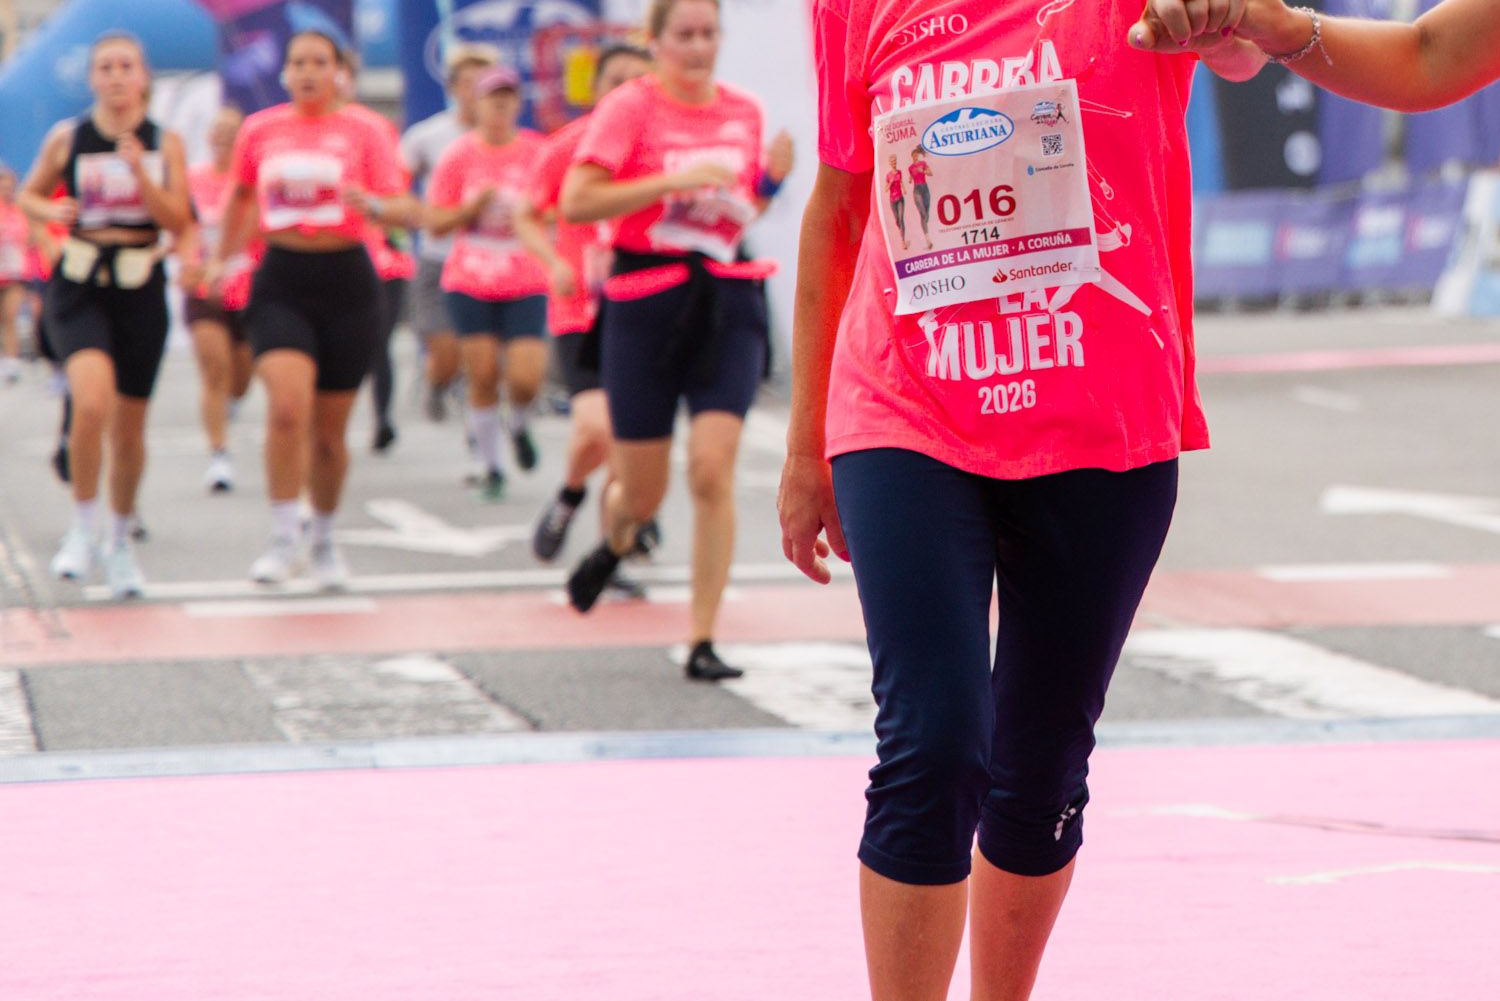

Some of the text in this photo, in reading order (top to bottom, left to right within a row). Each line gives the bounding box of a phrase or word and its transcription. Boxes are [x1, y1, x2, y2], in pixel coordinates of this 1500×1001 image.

[886, 126, 918, 144] SUMA
[929, 123, 1008, 150] ASTURIANA
[937, 184, 1017, 226] 016
[904, 232, 1073, 274] CARRERA DE LA MUJER A CORUÑA
[961, 226, 1000, 245] 1714
[913, 261, 1073, 300] OYSHO Santander
[925, 311, 1085, 381] MUJER
[978, 379, 1037, 415] 2026
